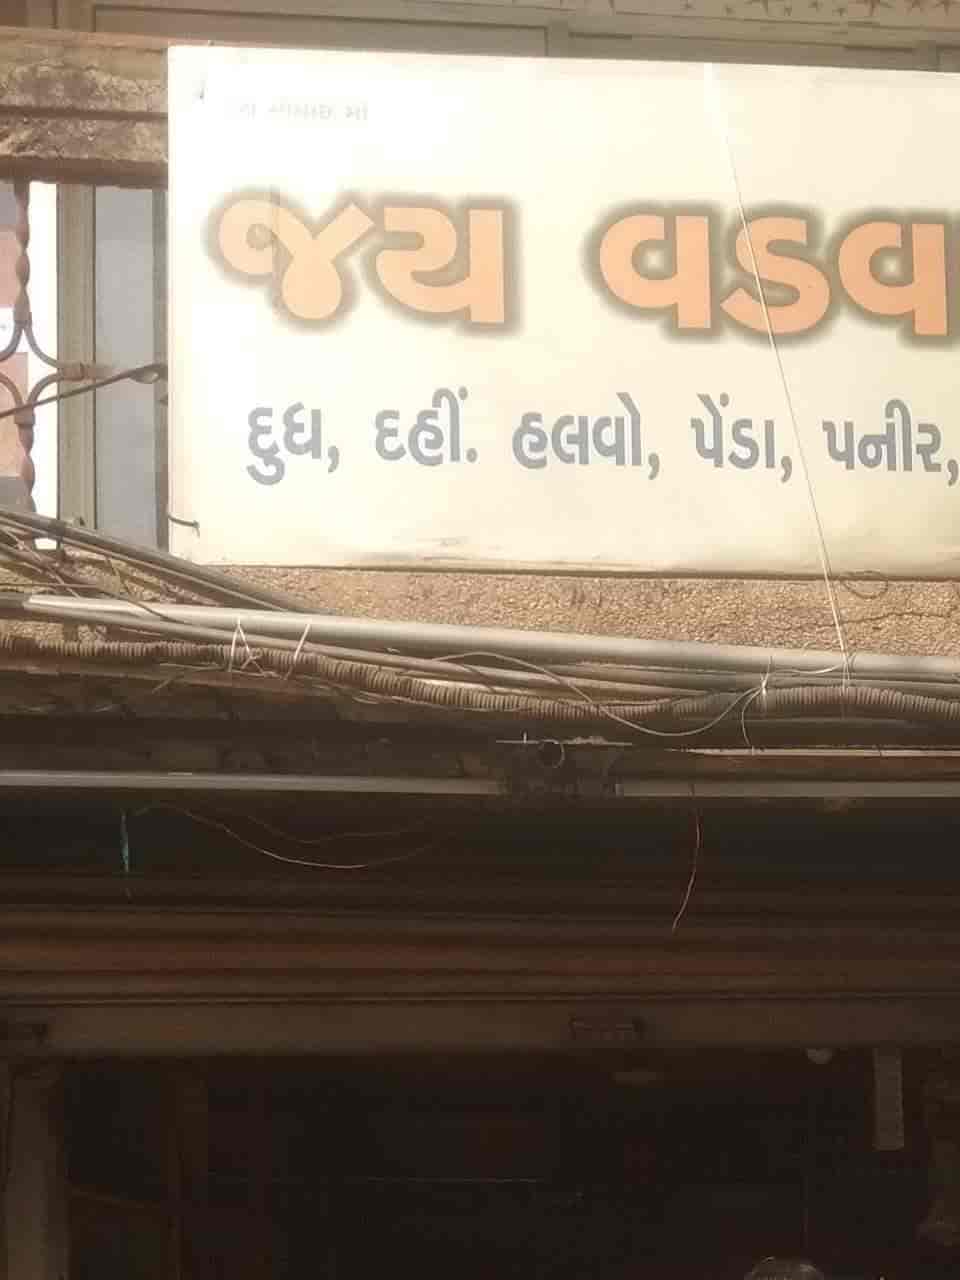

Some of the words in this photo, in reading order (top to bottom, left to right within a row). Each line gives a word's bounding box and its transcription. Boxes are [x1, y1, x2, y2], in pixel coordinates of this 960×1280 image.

[212, 193, 510, 327] જય
[246, 402, 340, 486] દુધ,
[511, 392, 660, 480] હલવો,
[690, 392, 793, 484] પેંડા,
[821, 398, 959, 487] પનીર,
